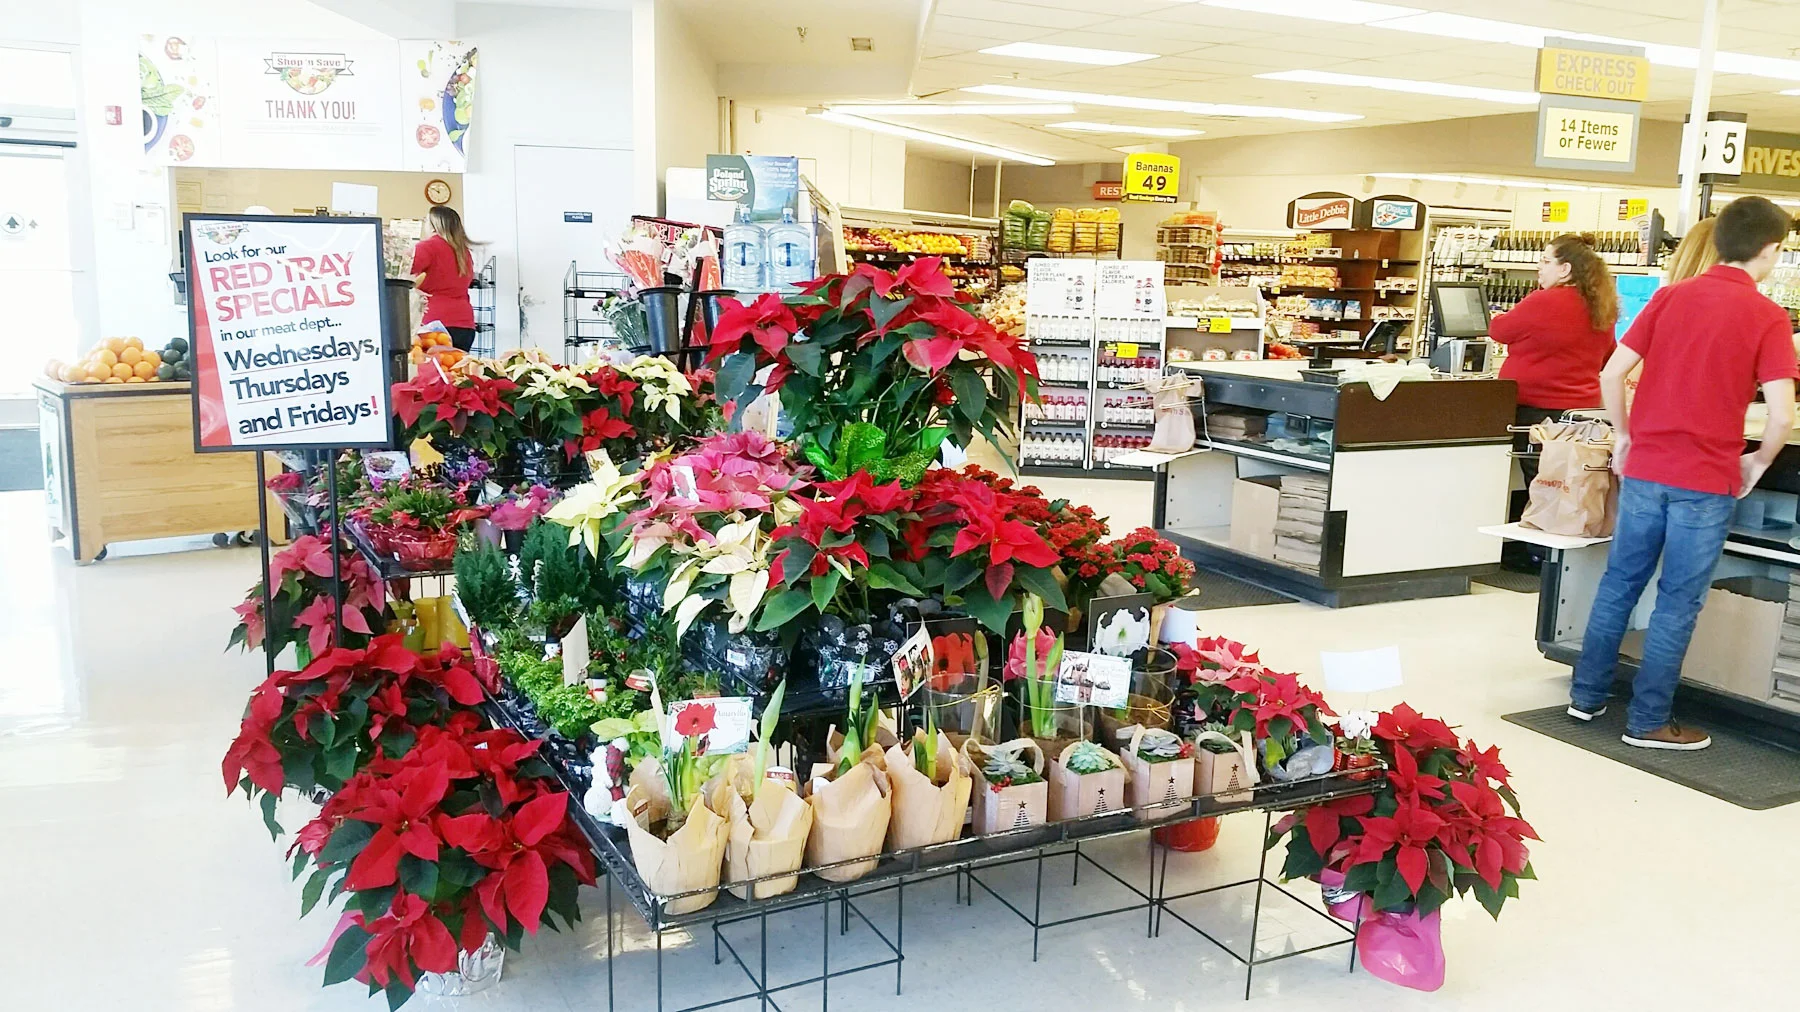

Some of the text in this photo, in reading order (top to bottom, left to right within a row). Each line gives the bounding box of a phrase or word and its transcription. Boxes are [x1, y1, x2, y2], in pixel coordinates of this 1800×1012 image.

[277, 57, 303, 66] Shop
[316, 58, 341, 67] Save
[1556, 53, 1637, 79] EXPRESS
[1555, 74, 1637, 96] CHECK OUT
[265, 100, 356, 120] THANK YOU!
[1560, 118, 1619, 136] 14 Items
[1559, 136, 1617, 152] or Fewer
[1722, 132, 1738, 164] 5
[713, 168, 745, 180] Poland
[1136, 161, 1174, 174] Bananas
[708, 177, 749, 194] Spring
[1142, 175, 1167, 191] 49
[1299, 204, 1347, 224] Little Debbie
[205, 244, 287, 263] Look for our
[209, 251, 355, 292] RED TRAY
[215, 281, 355, 322] SPECIALS
[220, 316, 342, 342] in our meat dept...
[224, 336, 380, 371] Wednesdays,
[229, 368, 350, 400] Thursdays
[239, 395, 379, 435] and Fridays!
